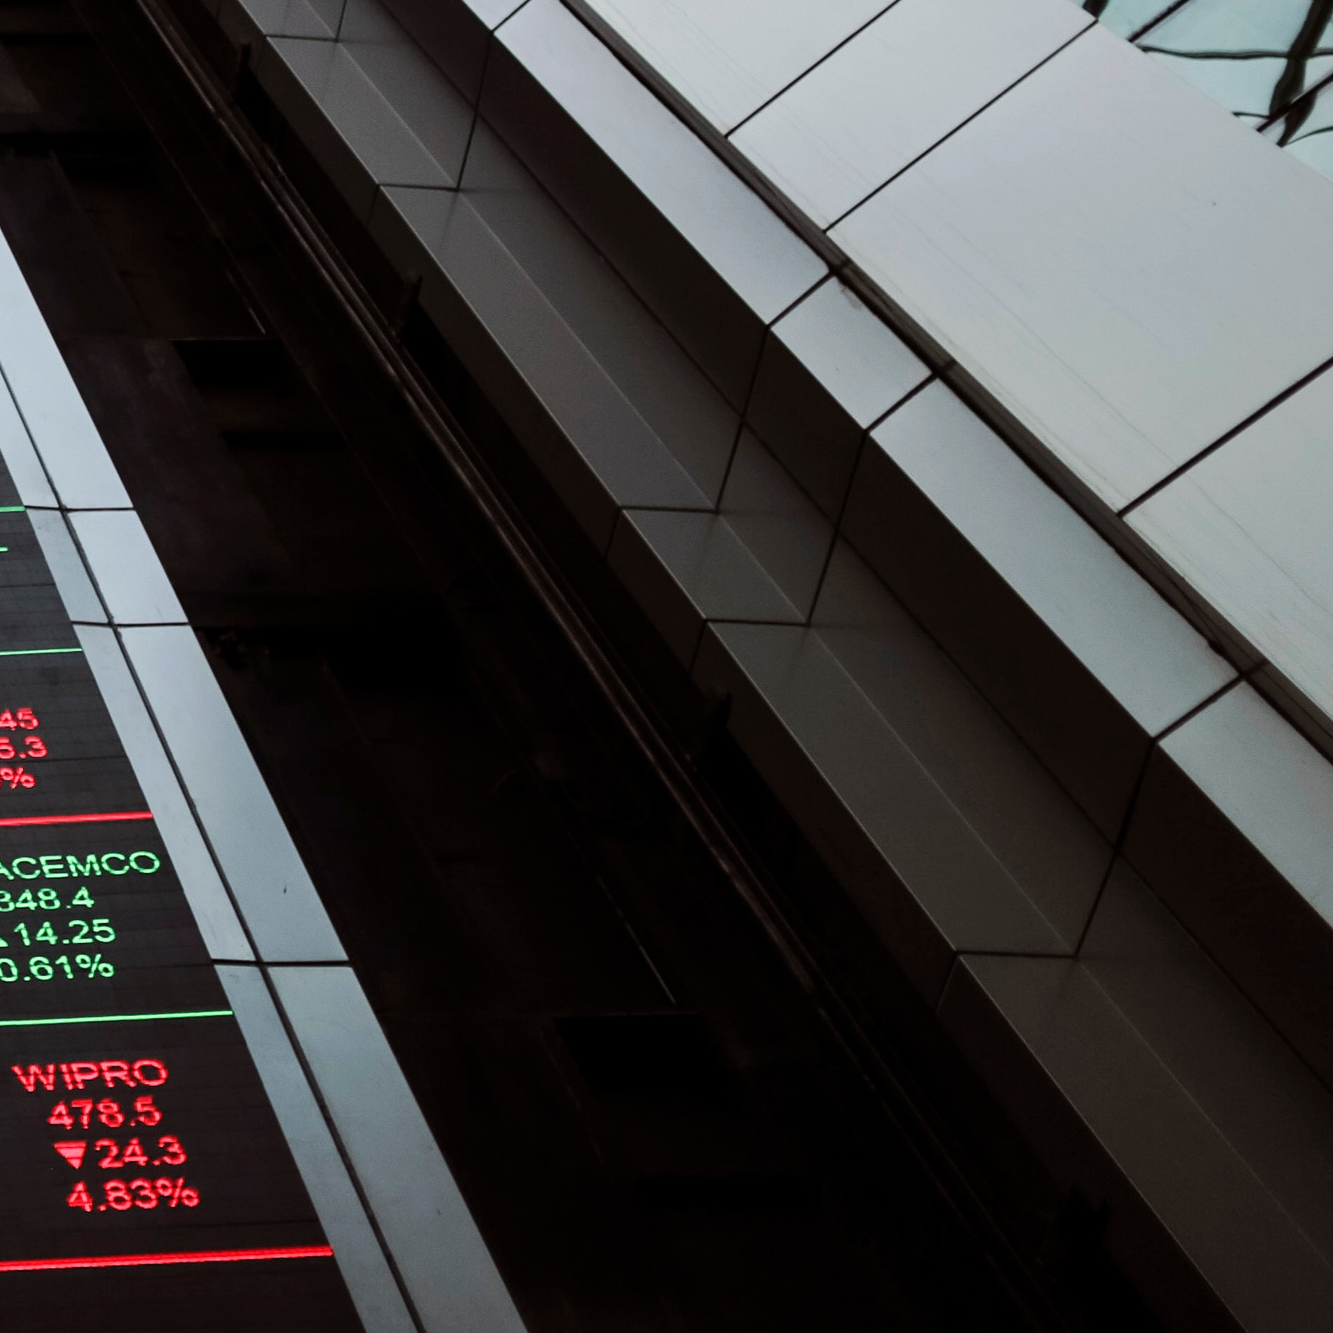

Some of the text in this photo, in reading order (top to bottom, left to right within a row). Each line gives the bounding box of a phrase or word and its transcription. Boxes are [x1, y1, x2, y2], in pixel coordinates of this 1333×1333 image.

[14, 918, 116, 946] 14.25
[11, 1059, 168, 1092] WIPRO
[47, 1096, 162, 1129] 478.5
[95, 1135, 187, 1168] 24.3
[67, 1177, 200, 1212] 4.83%
